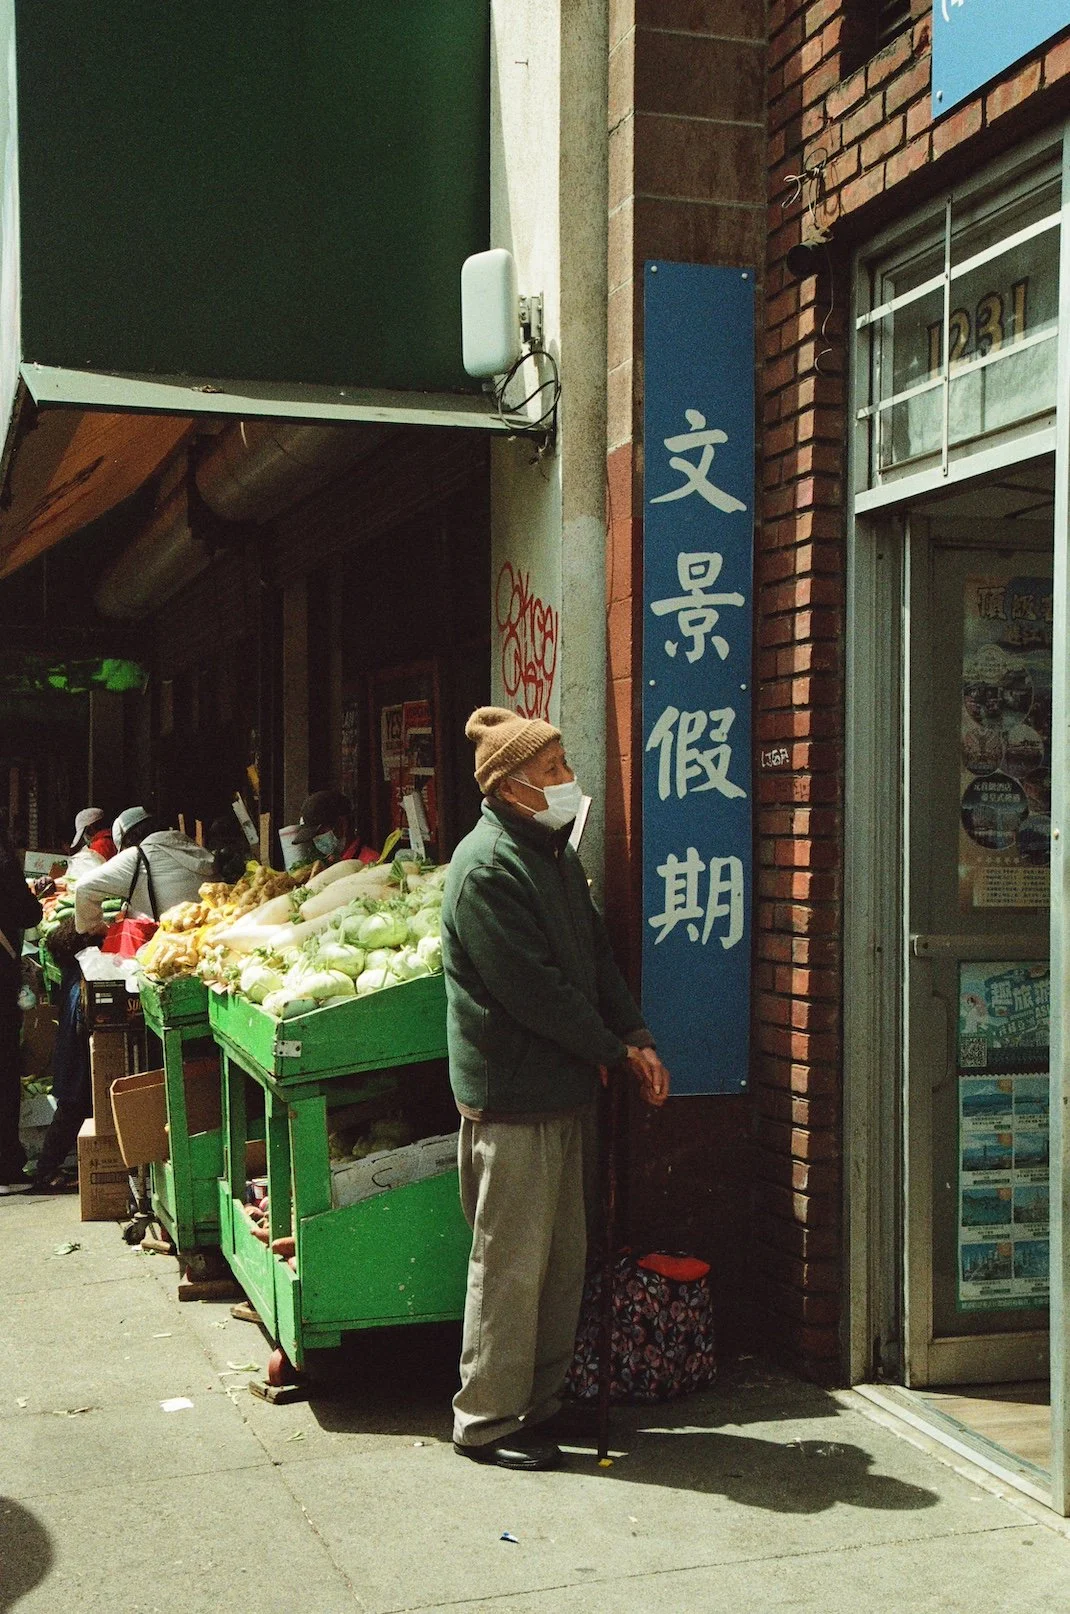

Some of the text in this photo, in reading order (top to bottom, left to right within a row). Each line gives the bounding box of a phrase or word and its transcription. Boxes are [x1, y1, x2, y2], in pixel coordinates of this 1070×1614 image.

[927, 276, 1029, 379] 1231
[645, 408, 747, 950] 文景假期
